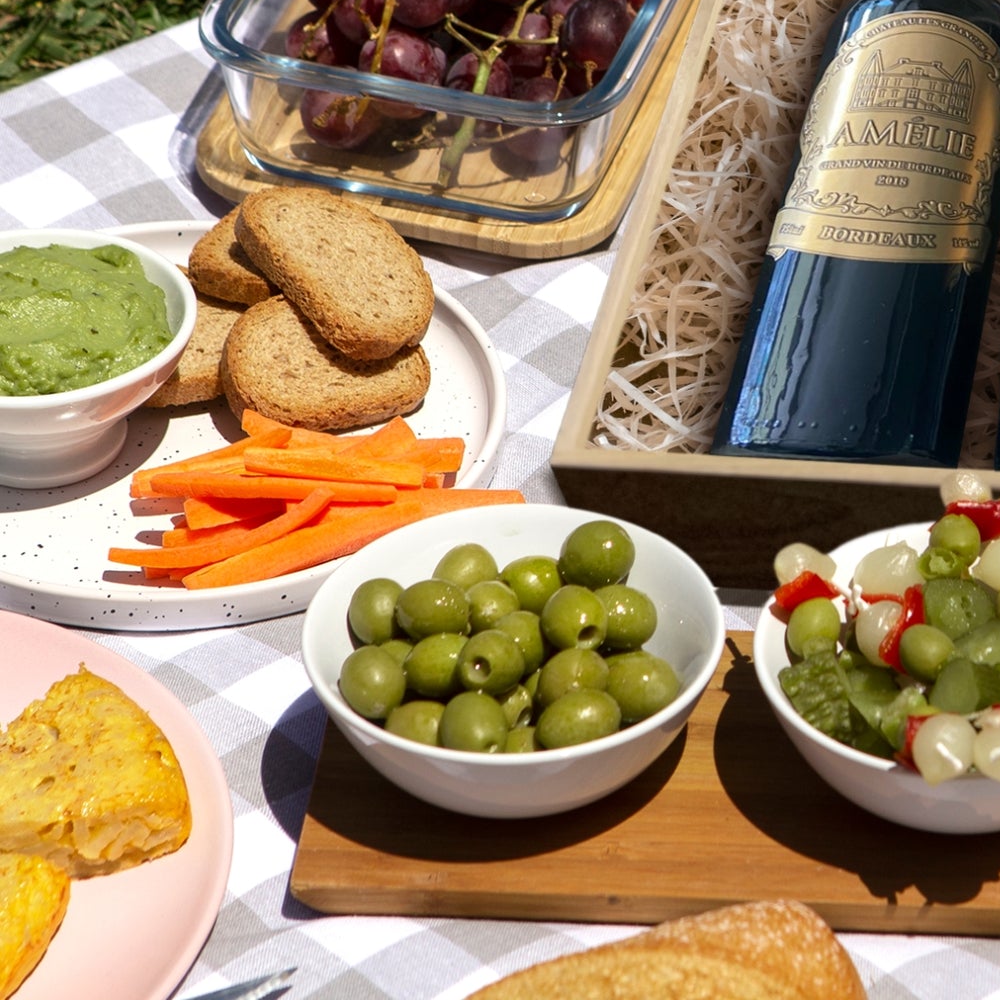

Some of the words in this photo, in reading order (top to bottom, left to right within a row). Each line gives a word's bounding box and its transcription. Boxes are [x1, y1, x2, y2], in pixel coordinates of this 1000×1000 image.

[828, 116, 977, 161] AMÉLIE
[819, 159, 861, 171] GRAND
[861, 159, 886, 169] VIN
[886, 159, 906, 171] DE
[906, 161, 972, 184] BORDEAUX
[875, 174, 909, 187] 2018
[818, 225, 937, 248] BORDEAUX
